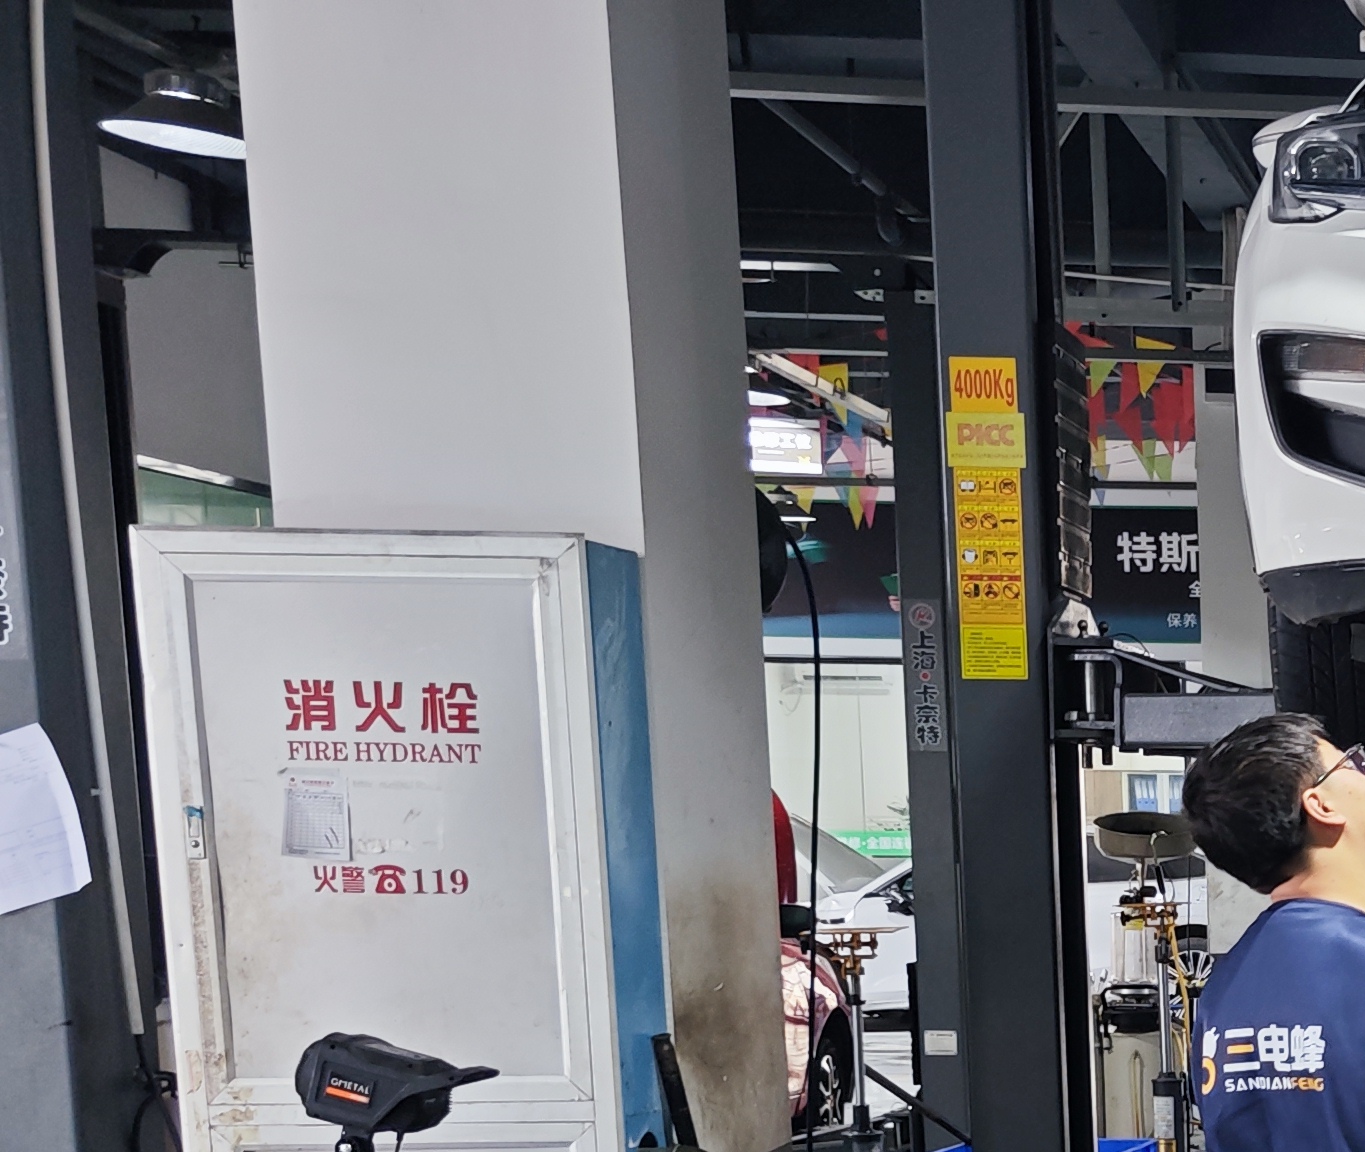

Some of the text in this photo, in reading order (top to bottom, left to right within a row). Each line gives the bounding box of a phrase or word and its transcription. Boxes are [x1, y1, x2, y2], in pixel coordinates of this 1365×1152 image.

[954, 368, 1015, 407] 4000Kg
[957, 423, 1015, 447] PICC
[1166, 612, 1197, 628] 保养
[283, 679, 480, 734] 消火栓
[287, 740, 482, 764] FIRE HYDRANT
[313, 865, 469, 895] 火警 119
[1223, 1024, 1326, 1073] 三电蜂
[1224, 1076, 1324, 1093] SANDIANFENG
